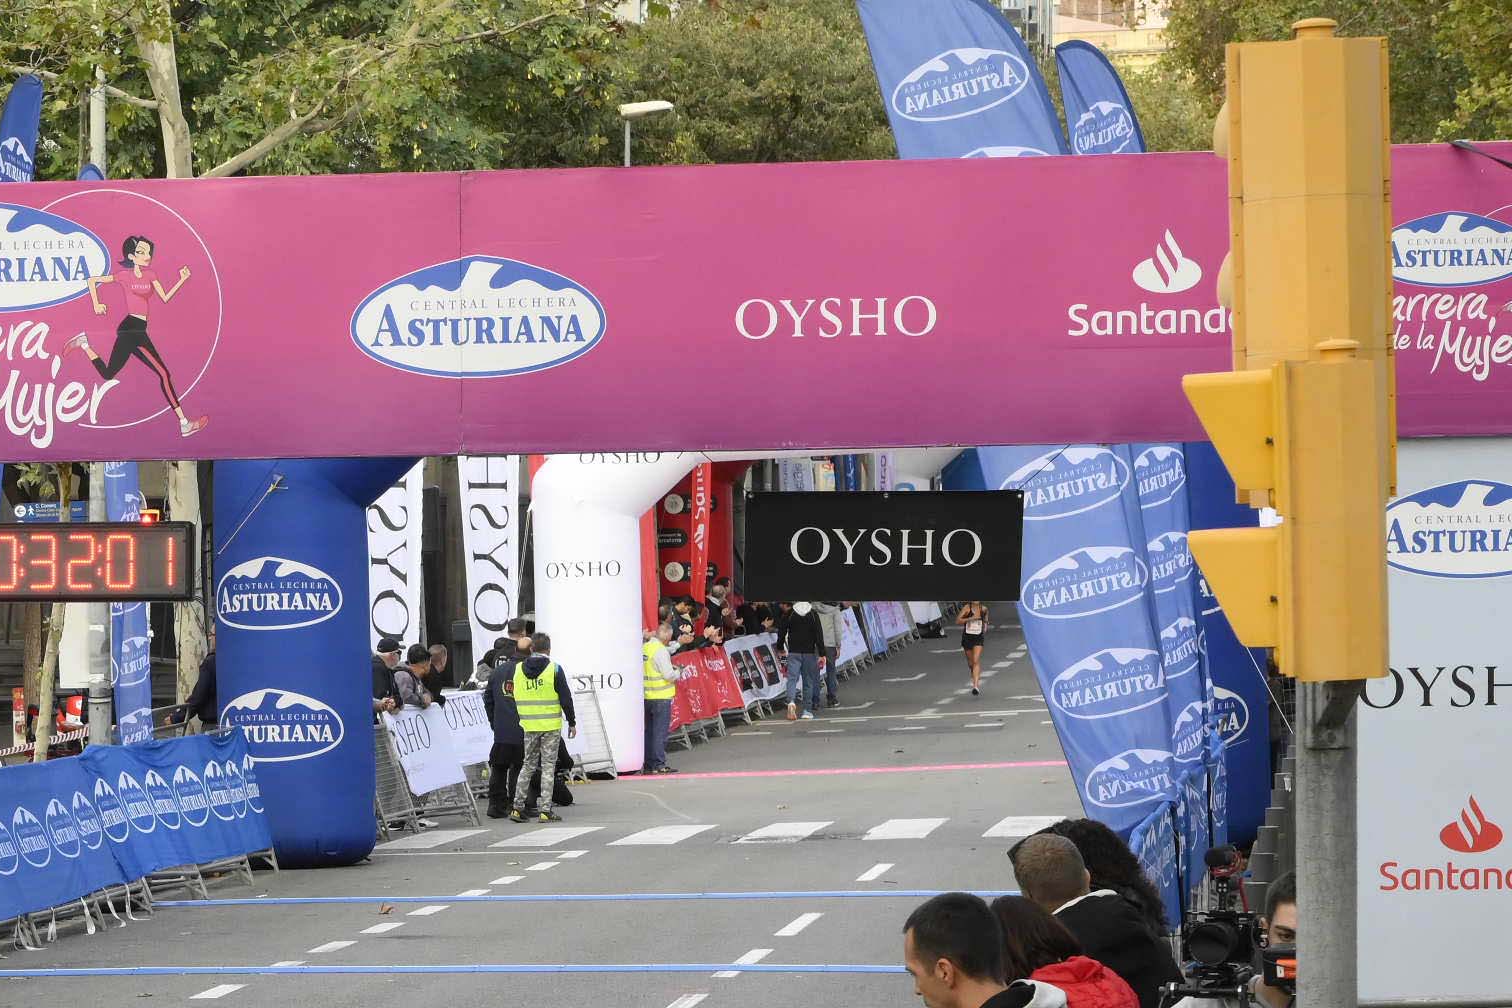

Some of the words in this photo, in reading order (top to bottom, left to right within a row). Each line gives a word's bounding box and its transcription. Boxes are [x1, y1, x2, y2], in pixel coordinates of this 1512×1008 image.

[13, 239, 85, 250] LECHERA
[410, 298, 487, 312] CENTRAL
[497, 296, 577, 310] LECHERA
[735, 296, 937, 339] OYSHO
[1392, 293, 1488, 321] arrera
[370, 302, 586, 348] ASTURIANA
[1068, 302, 1232, 336] Santand
[1417, 321, 1434, 349] la
[1430, 316, 1512, 381] Muje
[1414, 514, 1481, 524] CENTRAL
[790, 527, 982, 567] OYSHO
[546, 559, 621, 580] OYSHO
[233, 582, 275, 590] CENTRAL
[280, 582, 328, 590] LECHERA
[221, 587, 333, 614] ASTURIANA
[574, 672, 623, 690] SHO
[1361, 665, 1512, 709] OYSH
[235, 714, 277, 722] CENTRAL
